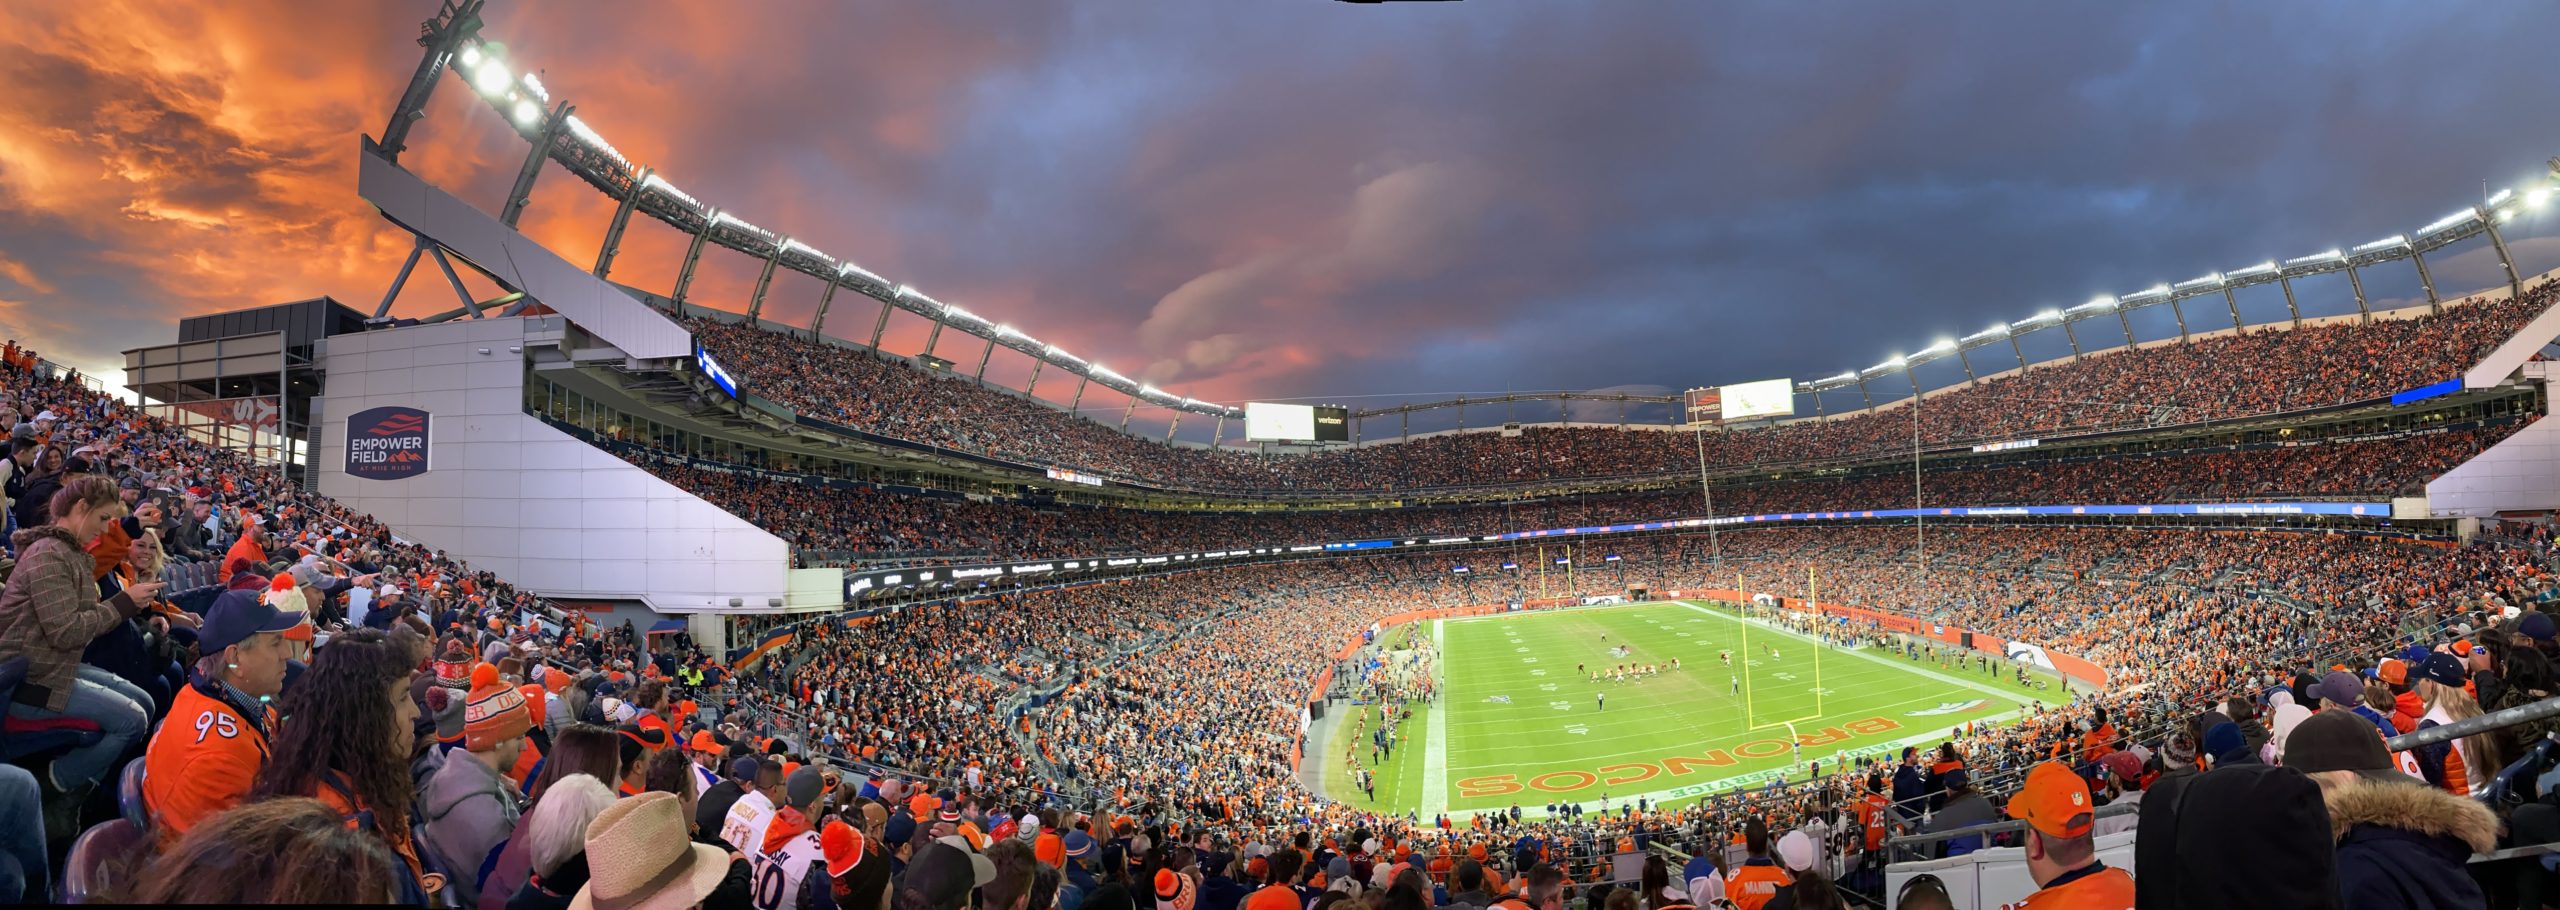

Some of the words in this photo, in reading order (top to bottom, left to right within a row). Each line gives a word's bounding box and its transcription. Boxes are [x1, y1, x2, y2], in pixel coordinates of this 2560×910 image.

[1317, 416, 1342, 425] verizon
[351, 436, 422, 451] EMPOWER
[351, 450, 387, 463] FIELD
[194, 710, 239, 744] 95
[1455, 716, 1904, 798] BRONCOS
